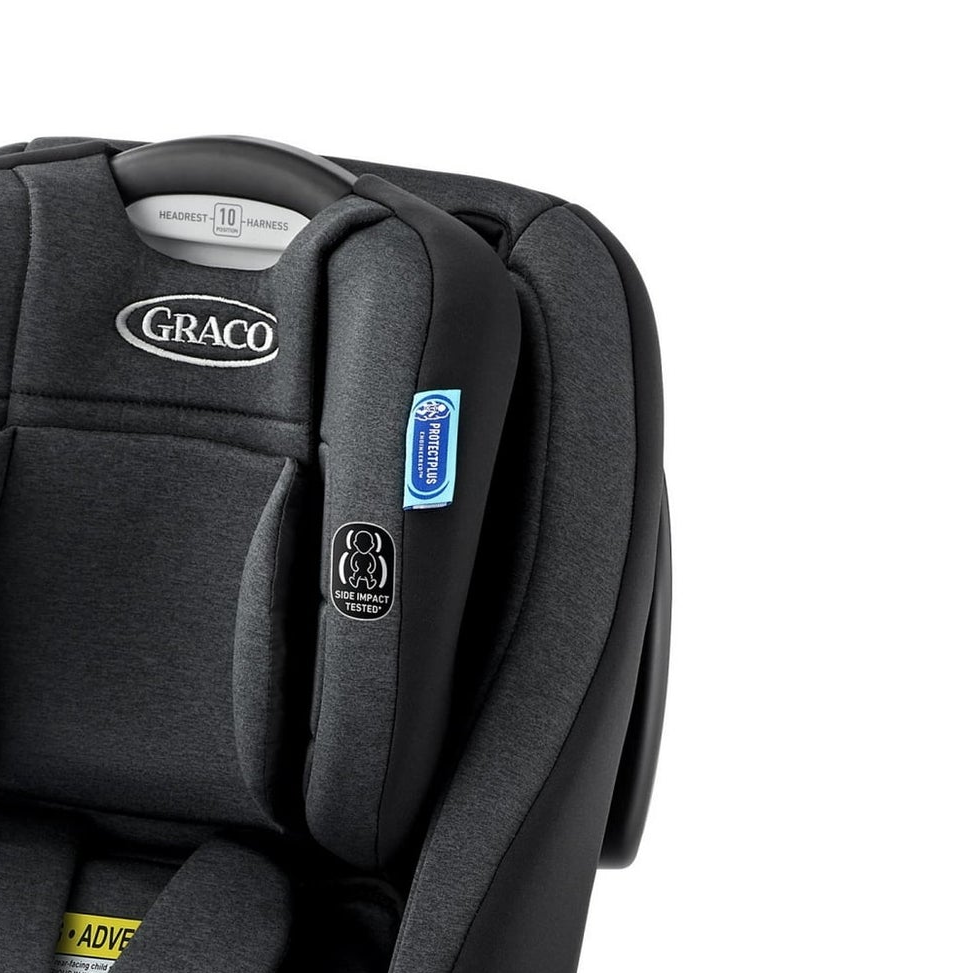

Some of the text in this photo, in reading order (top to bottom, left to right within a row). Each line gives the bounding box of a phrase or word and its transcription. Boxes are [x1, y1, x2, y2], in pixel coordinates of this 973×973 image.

[159, 207, 289, 231] HEADREST 10 HARNESS
[141, 306, 274, 353] GRACO
[425, 422, 441, 485] PROTECTPLUS
[334, 590, 390, 604] SIDE IMPACT
[91, 962, 108, 971] child
